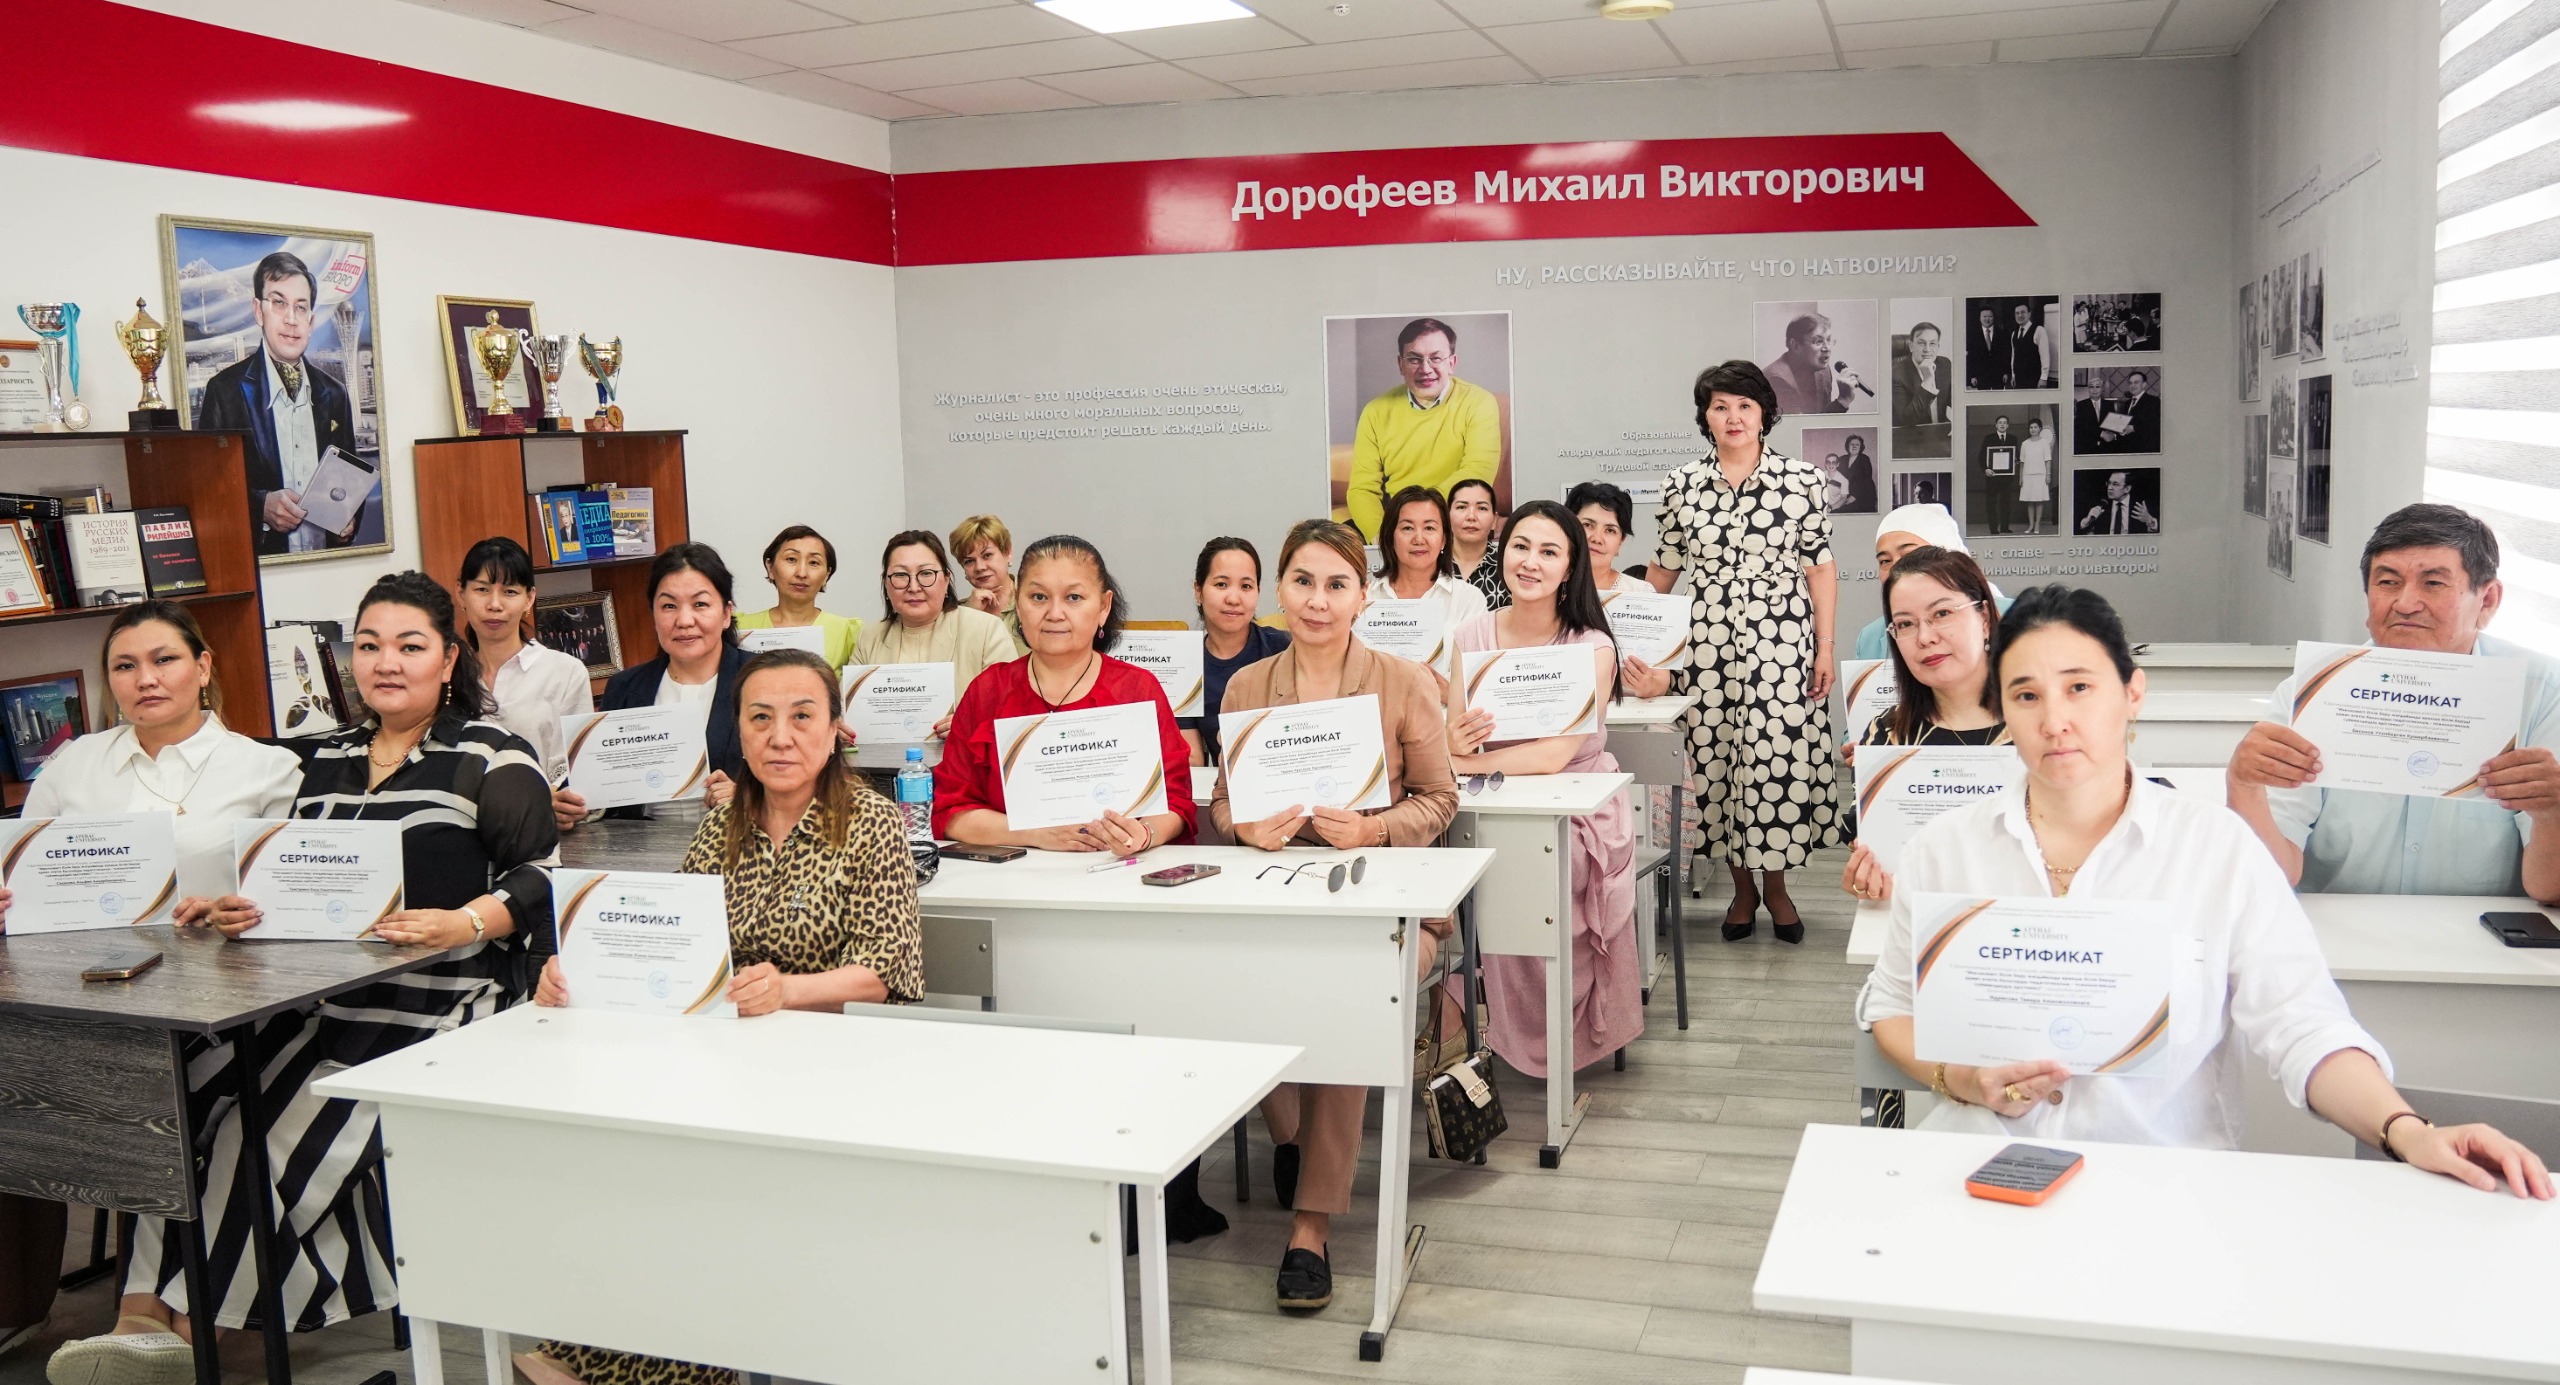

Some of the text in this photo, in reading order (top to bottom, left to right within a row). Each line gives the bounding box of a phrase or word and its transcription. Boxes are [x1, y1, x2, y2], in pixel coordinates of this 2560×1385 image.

[1232, 164, 1925, 221] Дорофеев Михаил Викторович
[330, 259, 361, 275] inform
[1495, 254, 1958, 288] НУ, РАССКАЗЫВАЙТЕ, ЧТО НАТВОРИЛИ?
[934, 391, 1021, 407] Журналист
[1035, 391, 1060, 403] это
[1064, 387, 1148, 403] профессия
[1152, 386, 1198, 398] очень
[1203, 382, 1288, 396] этическая,
[975, 402, 1244, 424] очень много моральных вопросов,
[1018, 425, 1097, 442] предстоит
[1100, 424, 1157, 439] решать
[1161, 420, 1225, 436] каждый
[1229, 419, 1272, 434] день.
[1621, 430, 1692, 442] Образование
[1558, 446, 1622, 459] Атырауский
[1599, 461, 1650, 473] Трудовой
[612, 509, 649, 519] Педагогика
[83, 520, 128, 529] ИСТОРИЯ
[145, 522, 189, 532] ПАБЛИК
[85, 527, 129, 537] РУССКИХ
[147, 530, 191, 540] РИЛЕЙШНЗ
[592, 533, 612, 544] 100%
[92, 536, 126, 545] МЕДИА
[1984, 550, 1993, 559] к
[2001, 548, 2043, 559] славе
[2068, 547, 2093, 558] это
[2099, 545, 2158, 559] хорошо
[1611, 612, 1663, 622] СЕРТИФИКАТ
[1499, 671, 1562, 684] СЕРТИФИКАТ
[872, 685, 926, 694] СЕРТИФИКАТ
[2350, 688, 2461, 708] СЕРТИФИКАТ
[601, 732, 670, 747] СЕРТИФИКАТ
[1265, 732, 1341, 749] СЕРТИФИКАТ
[1041, 739, 1118, 756] СЕРТИФИКАТ
[46, 846, 131, 859] СЕРТИФИКАТ
[279, 854, 360, 864] СЕРТИФИКАТ
[598, 912, 681, 926] СЕРТИФИКАТ
[1978, 946, 2104, 965] СЕРТИФИКАТ
